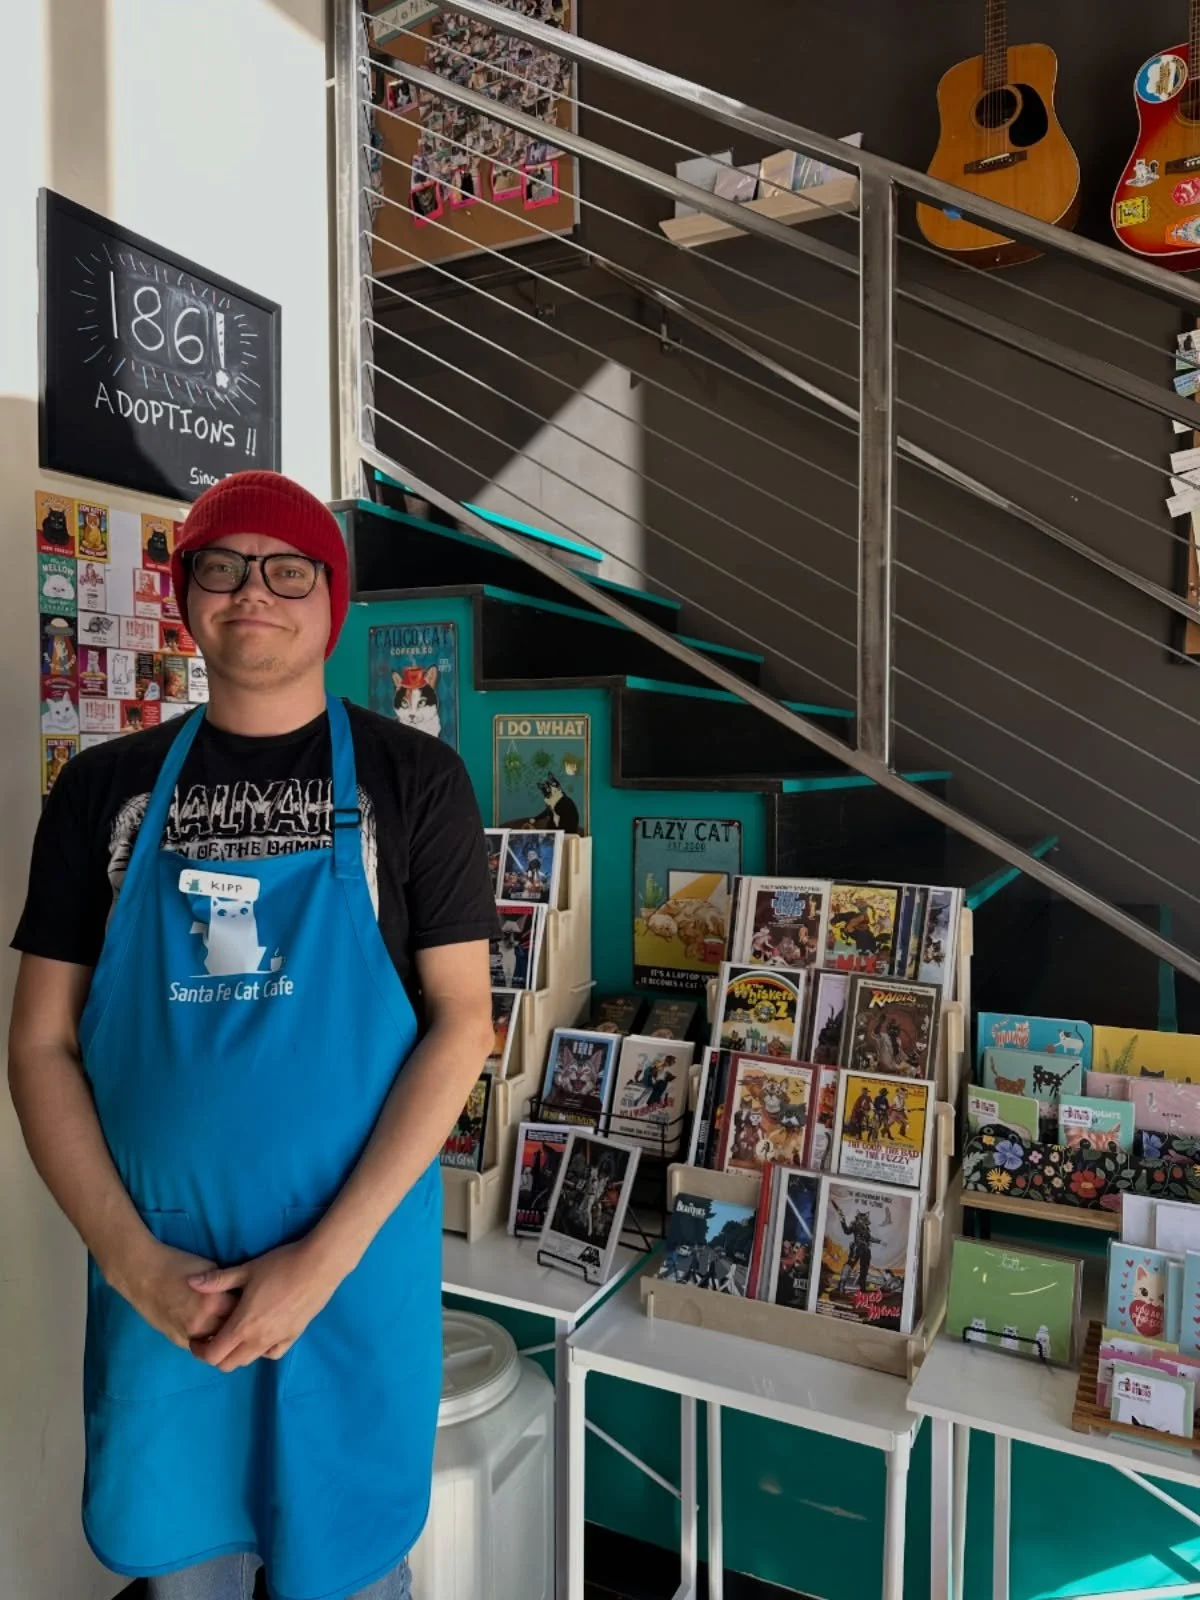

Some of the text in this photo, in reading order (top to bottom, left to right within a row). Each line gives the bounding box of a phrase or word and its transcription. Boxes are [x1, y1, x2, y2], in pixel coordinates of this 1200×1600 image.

[94, 381, 236, 448] ADOPTIONS
[374, 626, 450, 648] CALICO CAT
[498, 720, 585, 736] I DO WHAT
[641, 820, 734, 843] LAZY CAT
[196, 842, 219, 860] OF
[225, 840, 261, 857] THE
[211, 880, 243, 893] KIPP
[168, 981, 214, 1004] Santa
[215, 983, 232, 1003] Fe
[233, 980, 260, 1001] Cat
[881, 1152, 910, 1165] FUZZY
